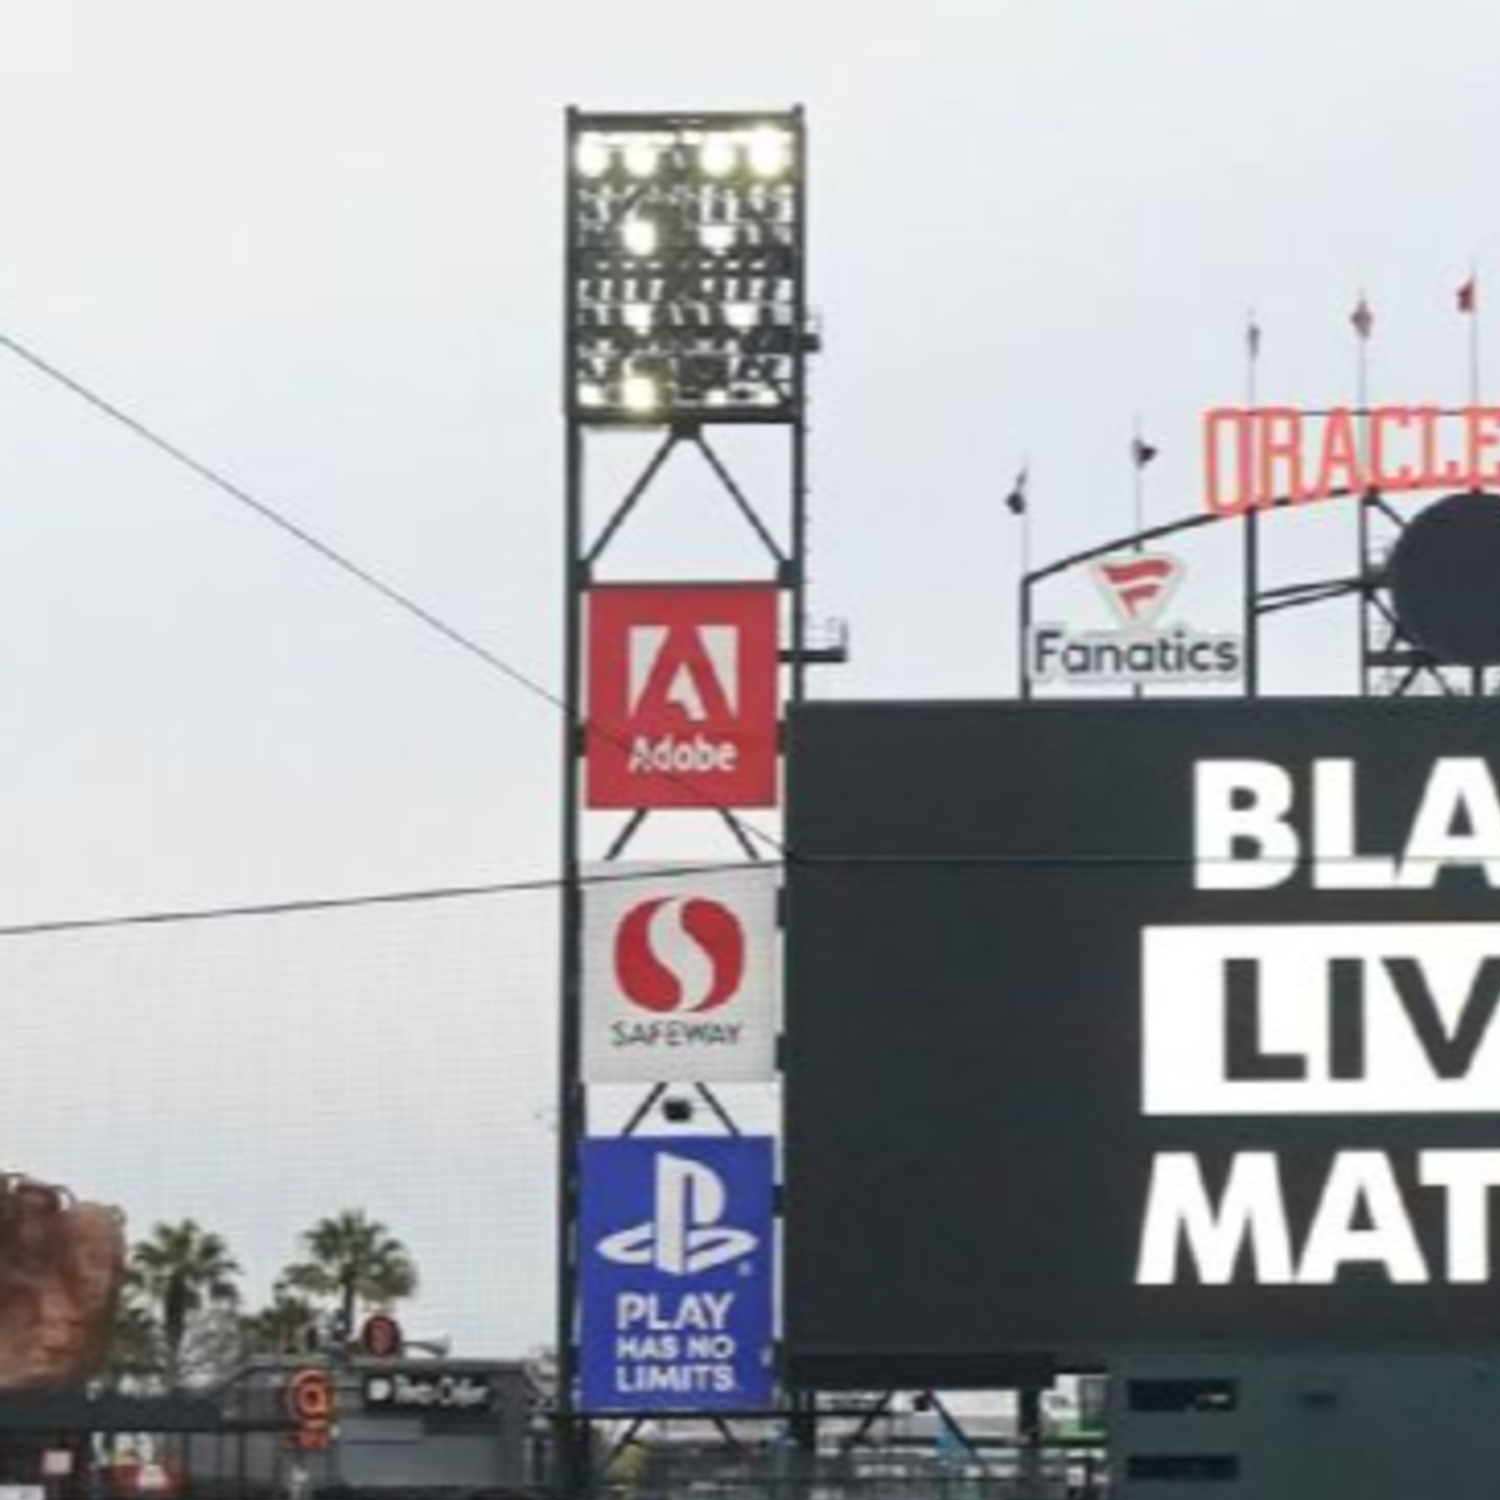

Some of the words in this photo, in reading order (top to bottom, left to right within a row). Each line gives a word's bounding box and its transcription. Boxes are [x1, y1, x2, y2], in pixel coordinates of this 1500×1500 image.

[1036, 630, 1239, 674] Fanatics
[628, 733, 738, 773] Adobe
[611, 1020, 741, 1047] SAFEWAY
[617, 1293, 734, 1331] PLAY
[617, 1335, 679, 1360] HAS
[687, 1335, 735, 1360] NO
[617, 1364, 736, 1392] LIMITS
